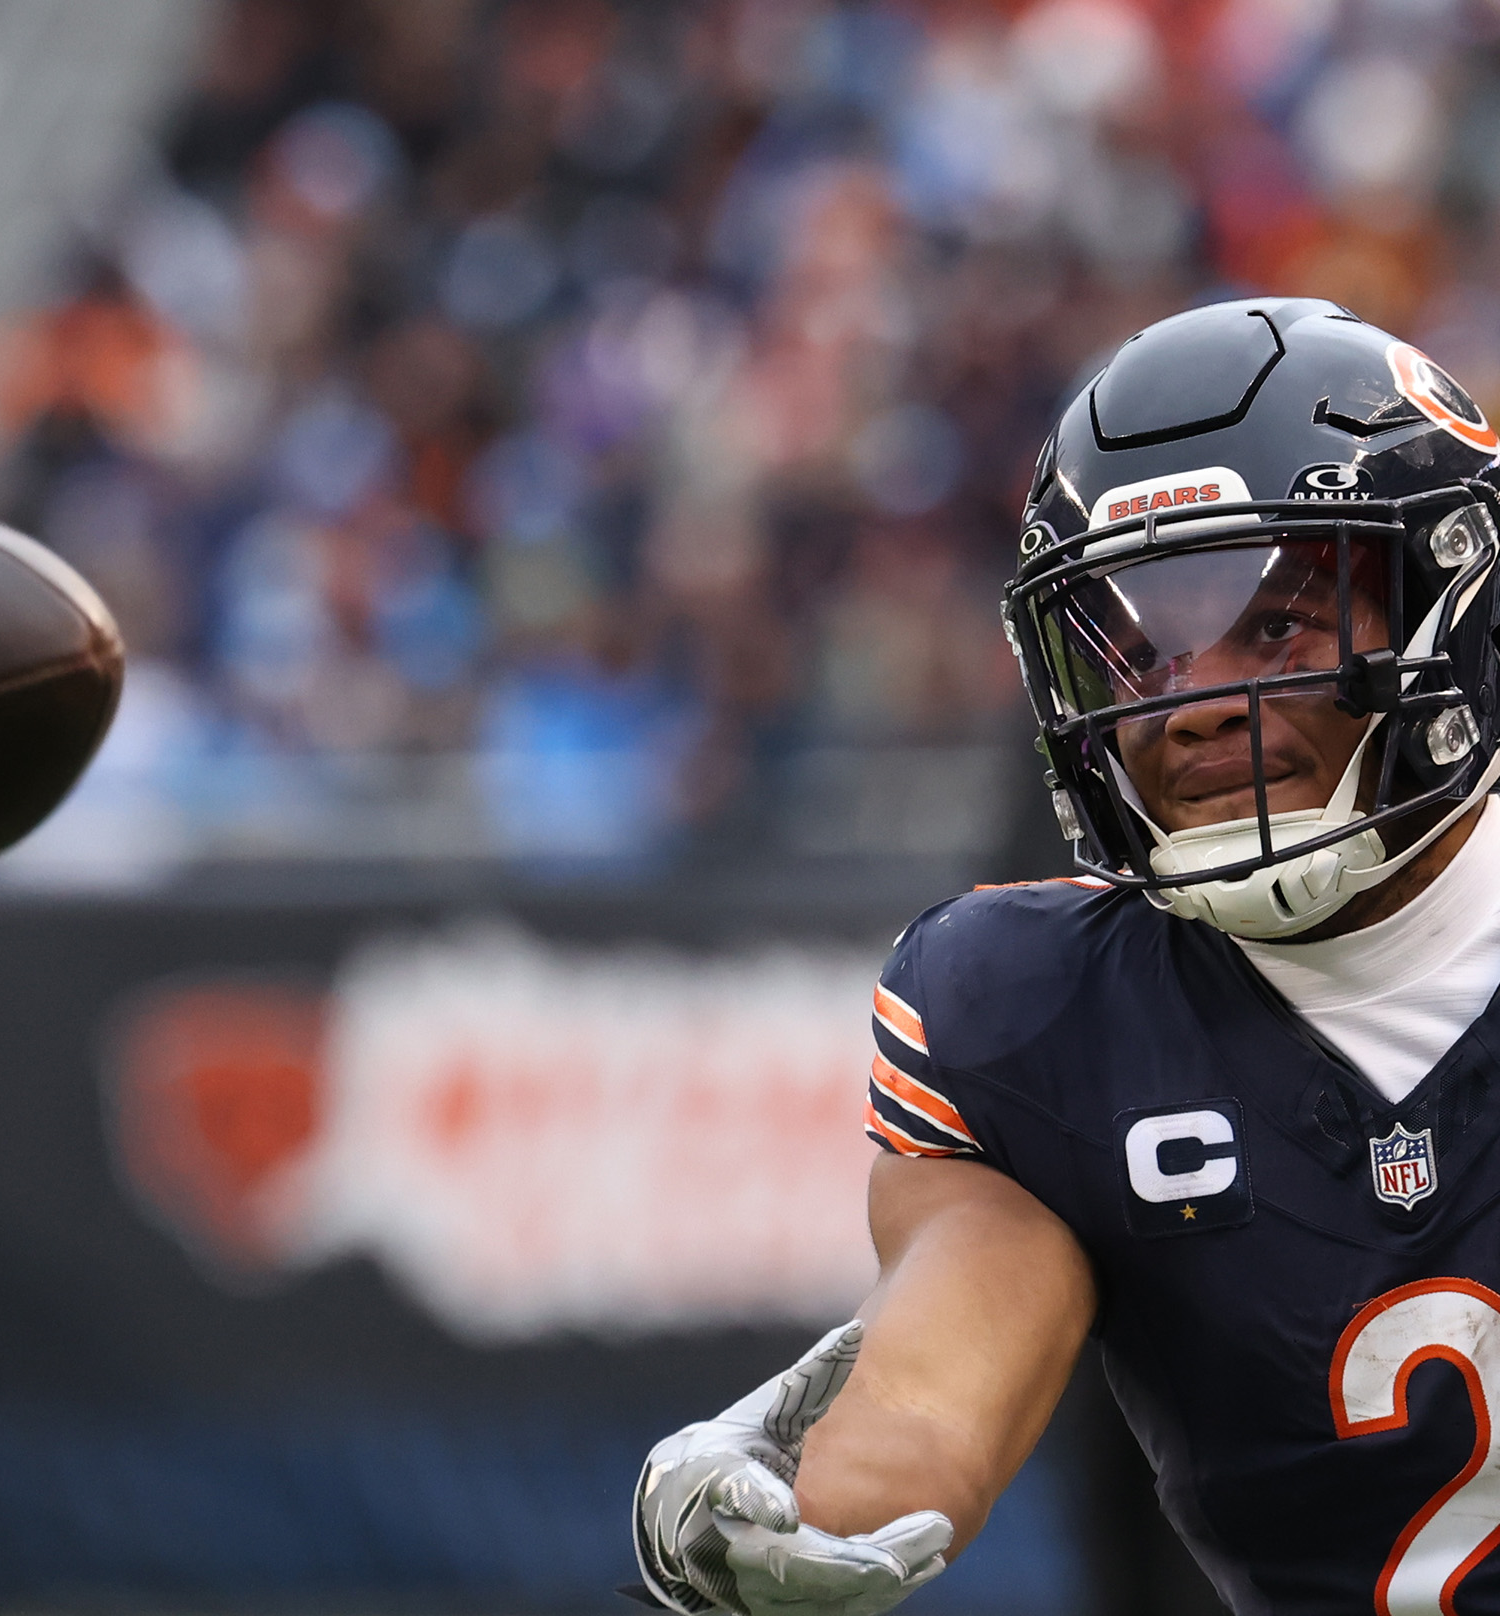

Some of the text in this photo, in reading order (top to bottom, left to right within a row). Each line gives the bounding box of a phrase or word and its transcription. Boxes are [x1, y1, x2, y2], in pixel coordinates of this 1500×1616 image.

[1108, 484, 1221, 521] BEARS
[1125, 1110, 1238, 1203] C
[1382, 1162, 1428, 1194] NFL
